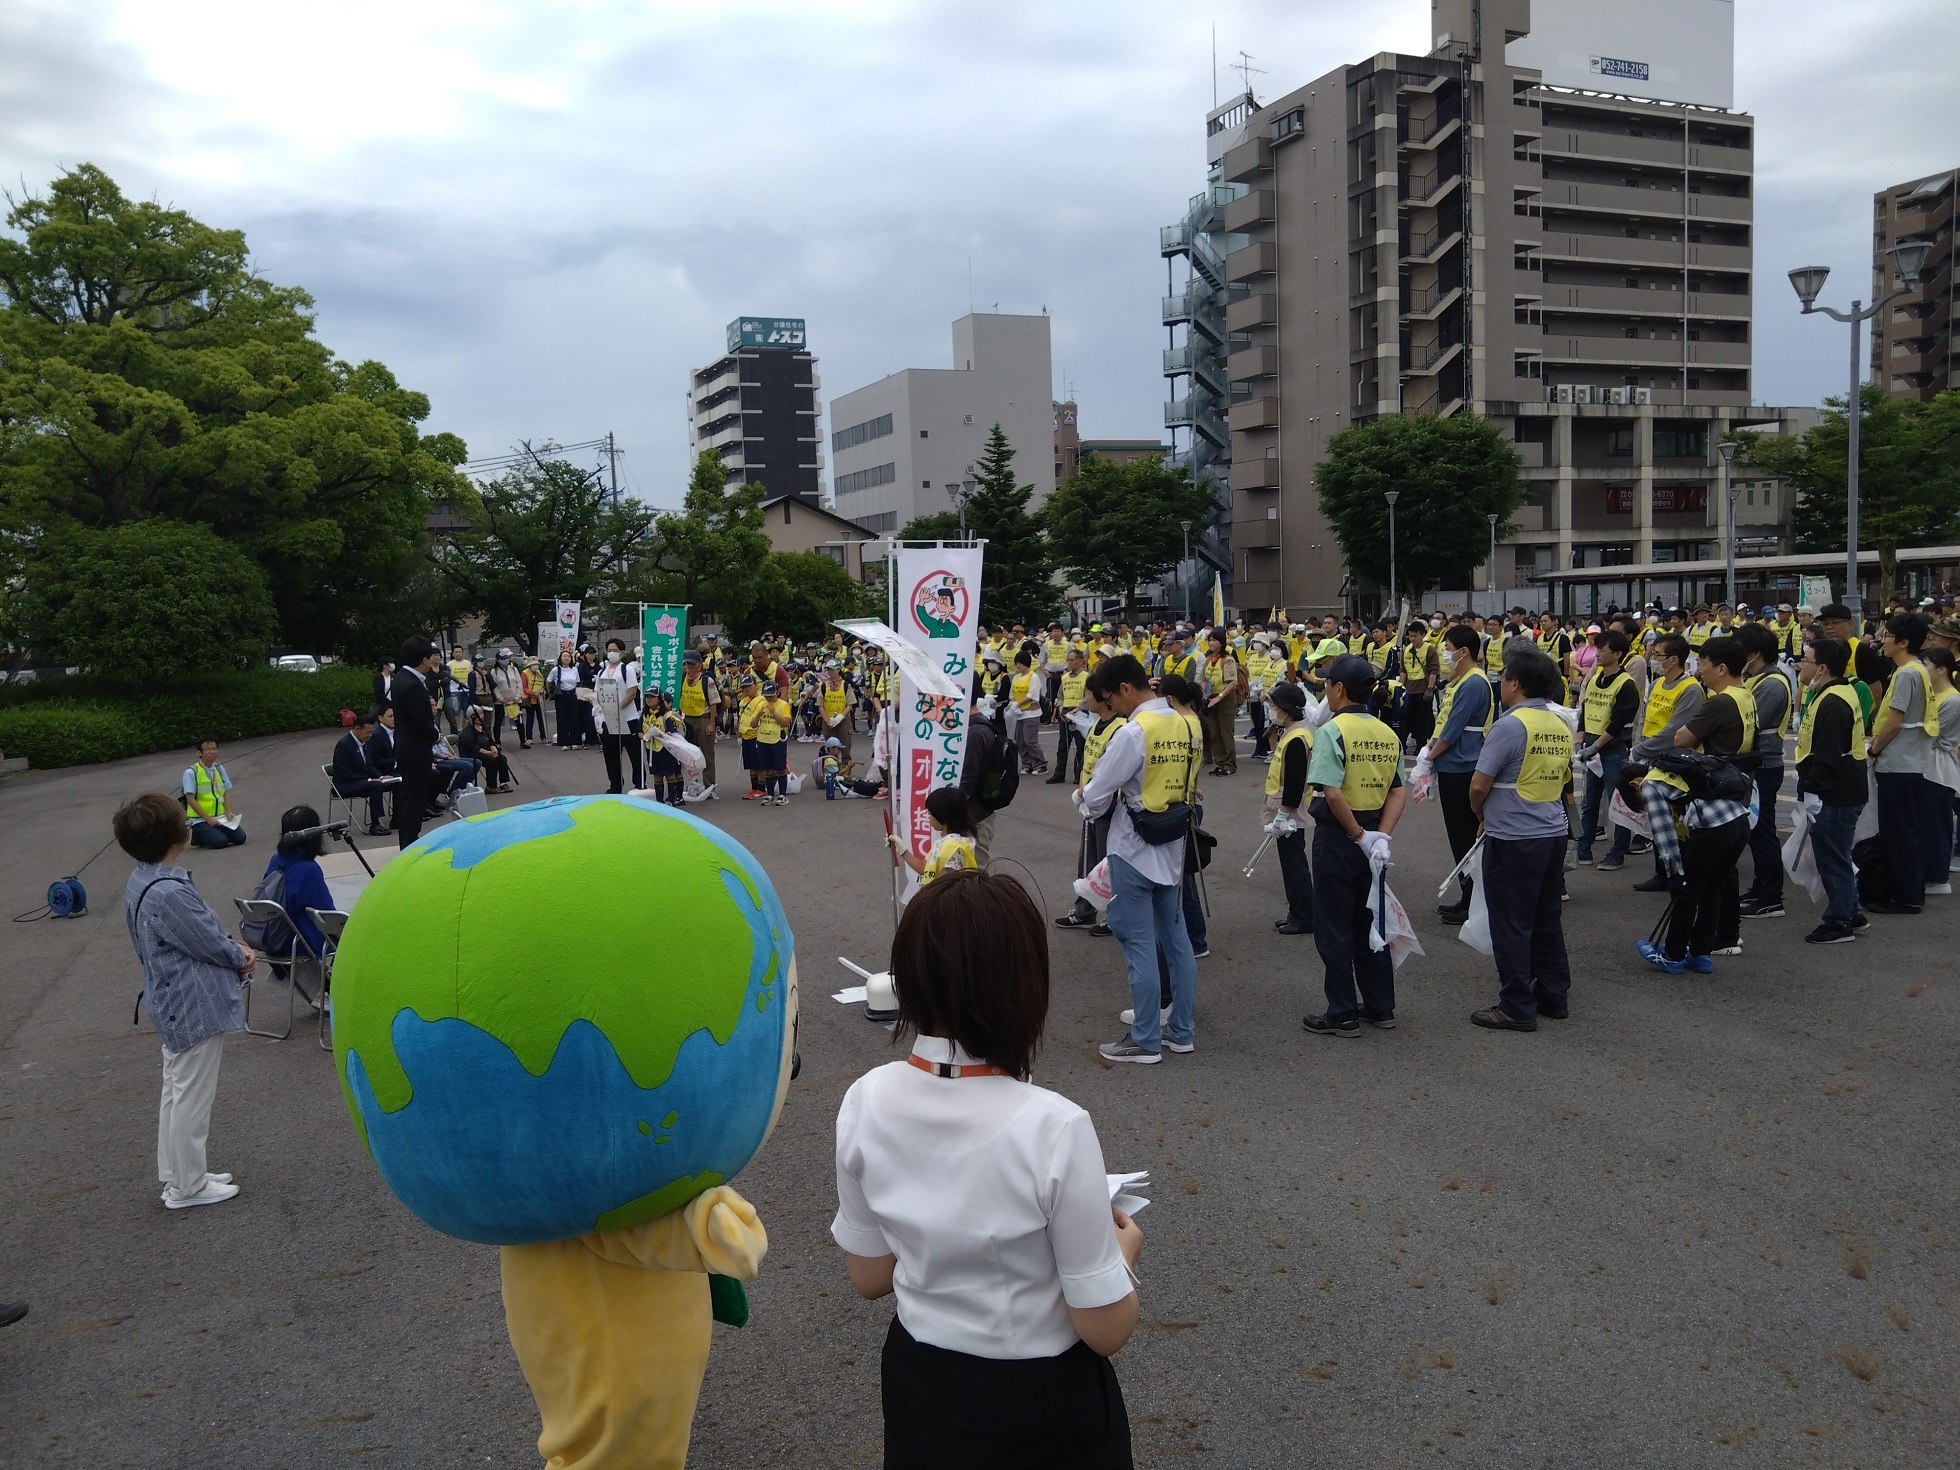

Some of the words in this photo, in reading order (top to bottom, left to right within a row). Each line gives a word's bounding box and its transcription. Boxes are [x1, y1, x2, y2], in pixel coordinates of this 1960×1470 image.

[1602, 59, 1648, 75] 052-741-2158
[767, 330, 804, 344] トスコ
